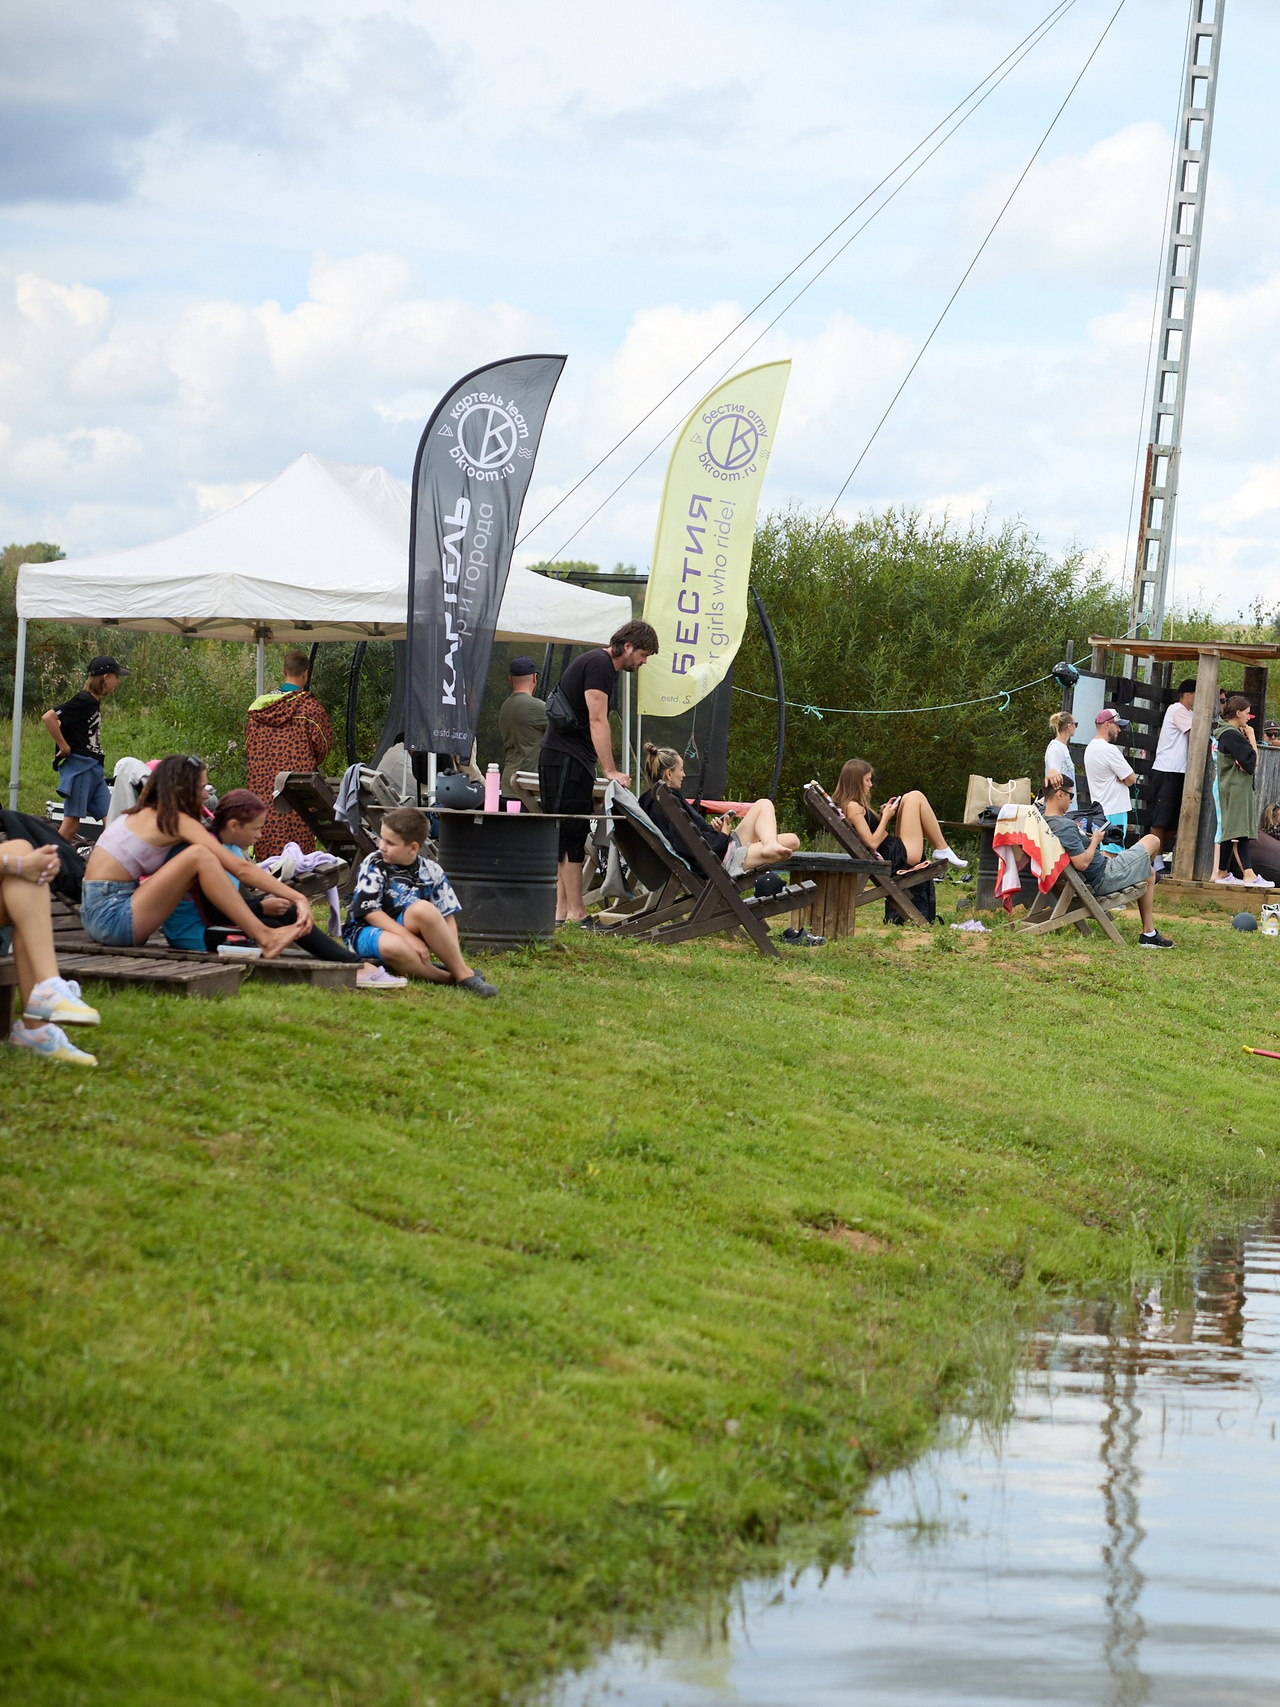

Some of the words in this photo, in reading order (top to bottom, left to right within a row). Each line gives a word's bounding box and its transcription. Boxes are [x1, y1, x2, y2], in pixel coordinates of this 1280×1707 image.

[450, 392, 504, 419] картель
[505, 400, 529, 439] team
[702, 403, 745, 424] бестия
[747, 409, 768, 438] army
[449, 445, 515, 481] bkroom.ru
[698, 452, 757, 481] bkroom.ru
[713, 499, 736, 548] ride!
[463, 503, 494, 591] города
[672, 494, 712, 675] БЕСТИЯ
[707, 554, 727, 596] who
[704, 602, 729, 646] girls
